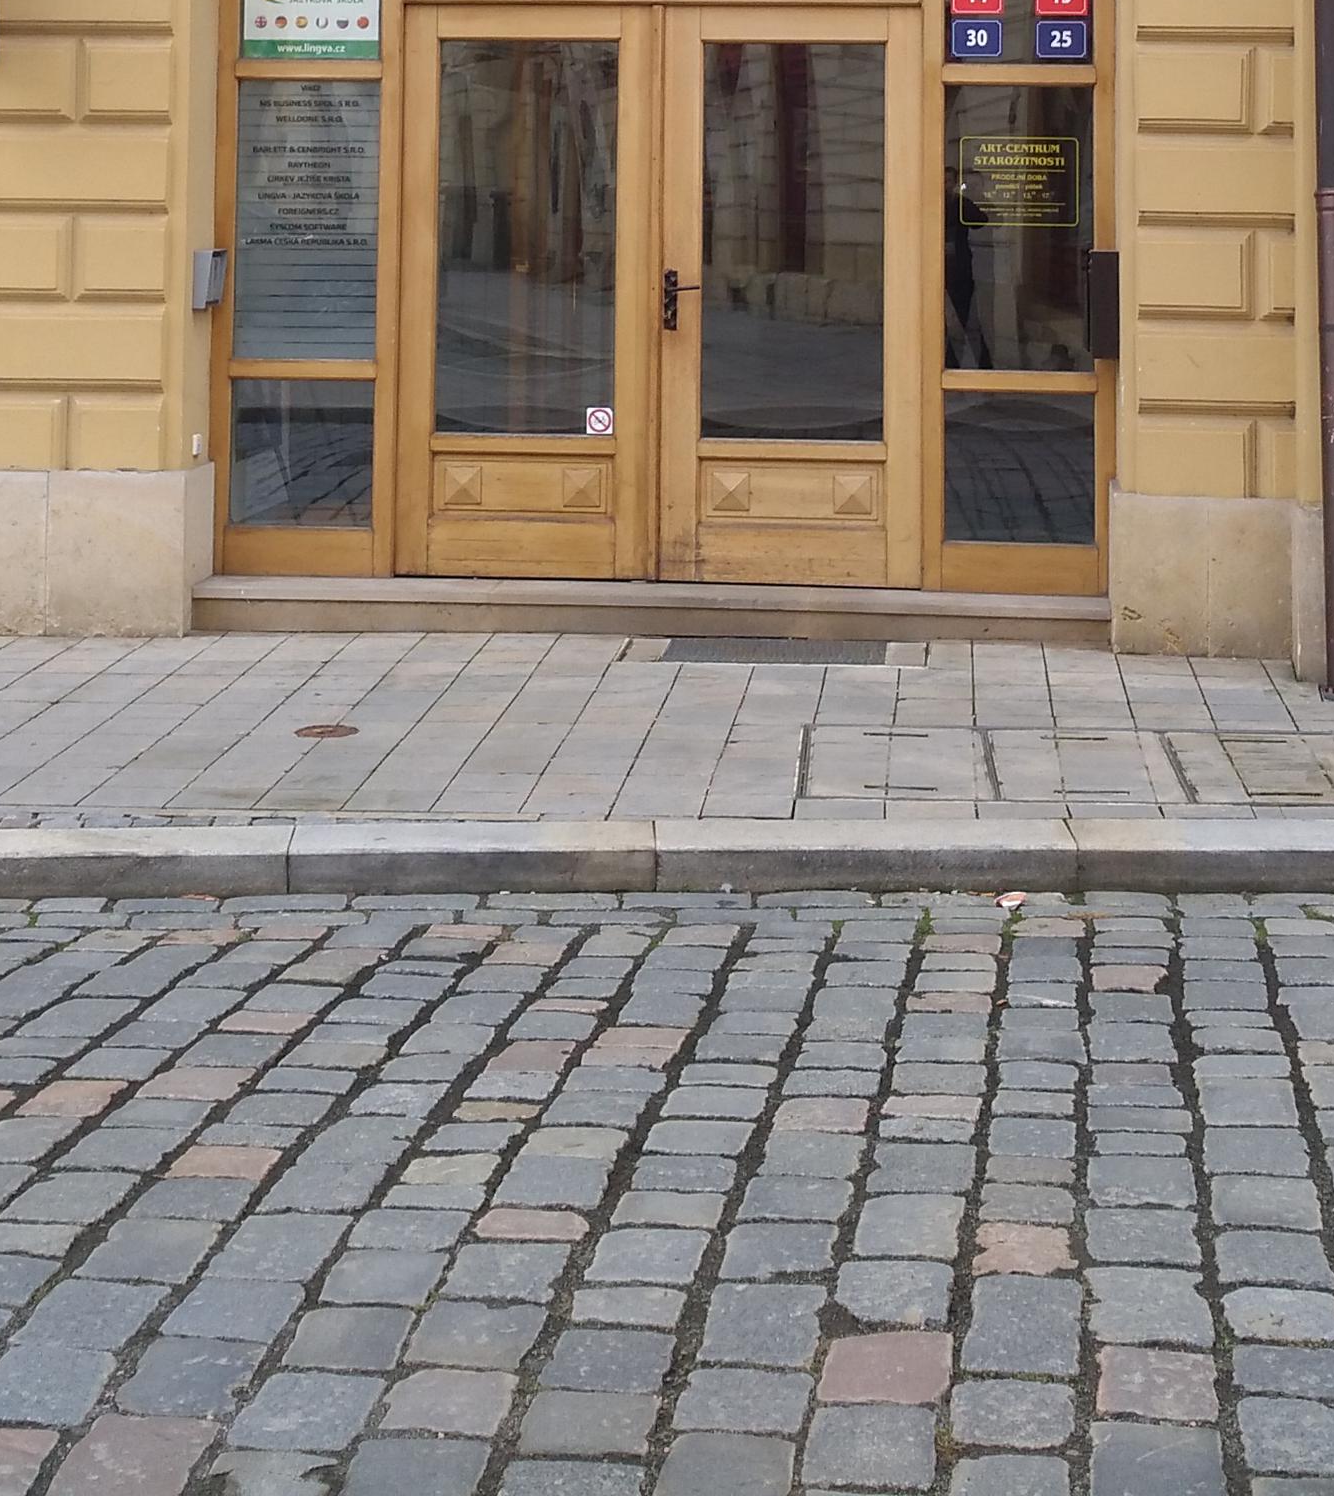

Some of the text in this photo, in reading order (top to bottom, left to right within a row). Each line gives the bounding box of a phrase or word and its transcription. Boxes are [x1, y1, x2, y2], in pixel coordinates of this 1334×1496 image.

[966, 29, 988, 47] 30
[1050, 30, 1072, 48] 25
[276, 43, 346, 55] www.lingva.cz
[979, 143, 1060, 153] ART-CENTRUM
[287, 161, 331, 169] RAYTHEON
[973, 154, 1065, 166] STAROŽITNOSTI
